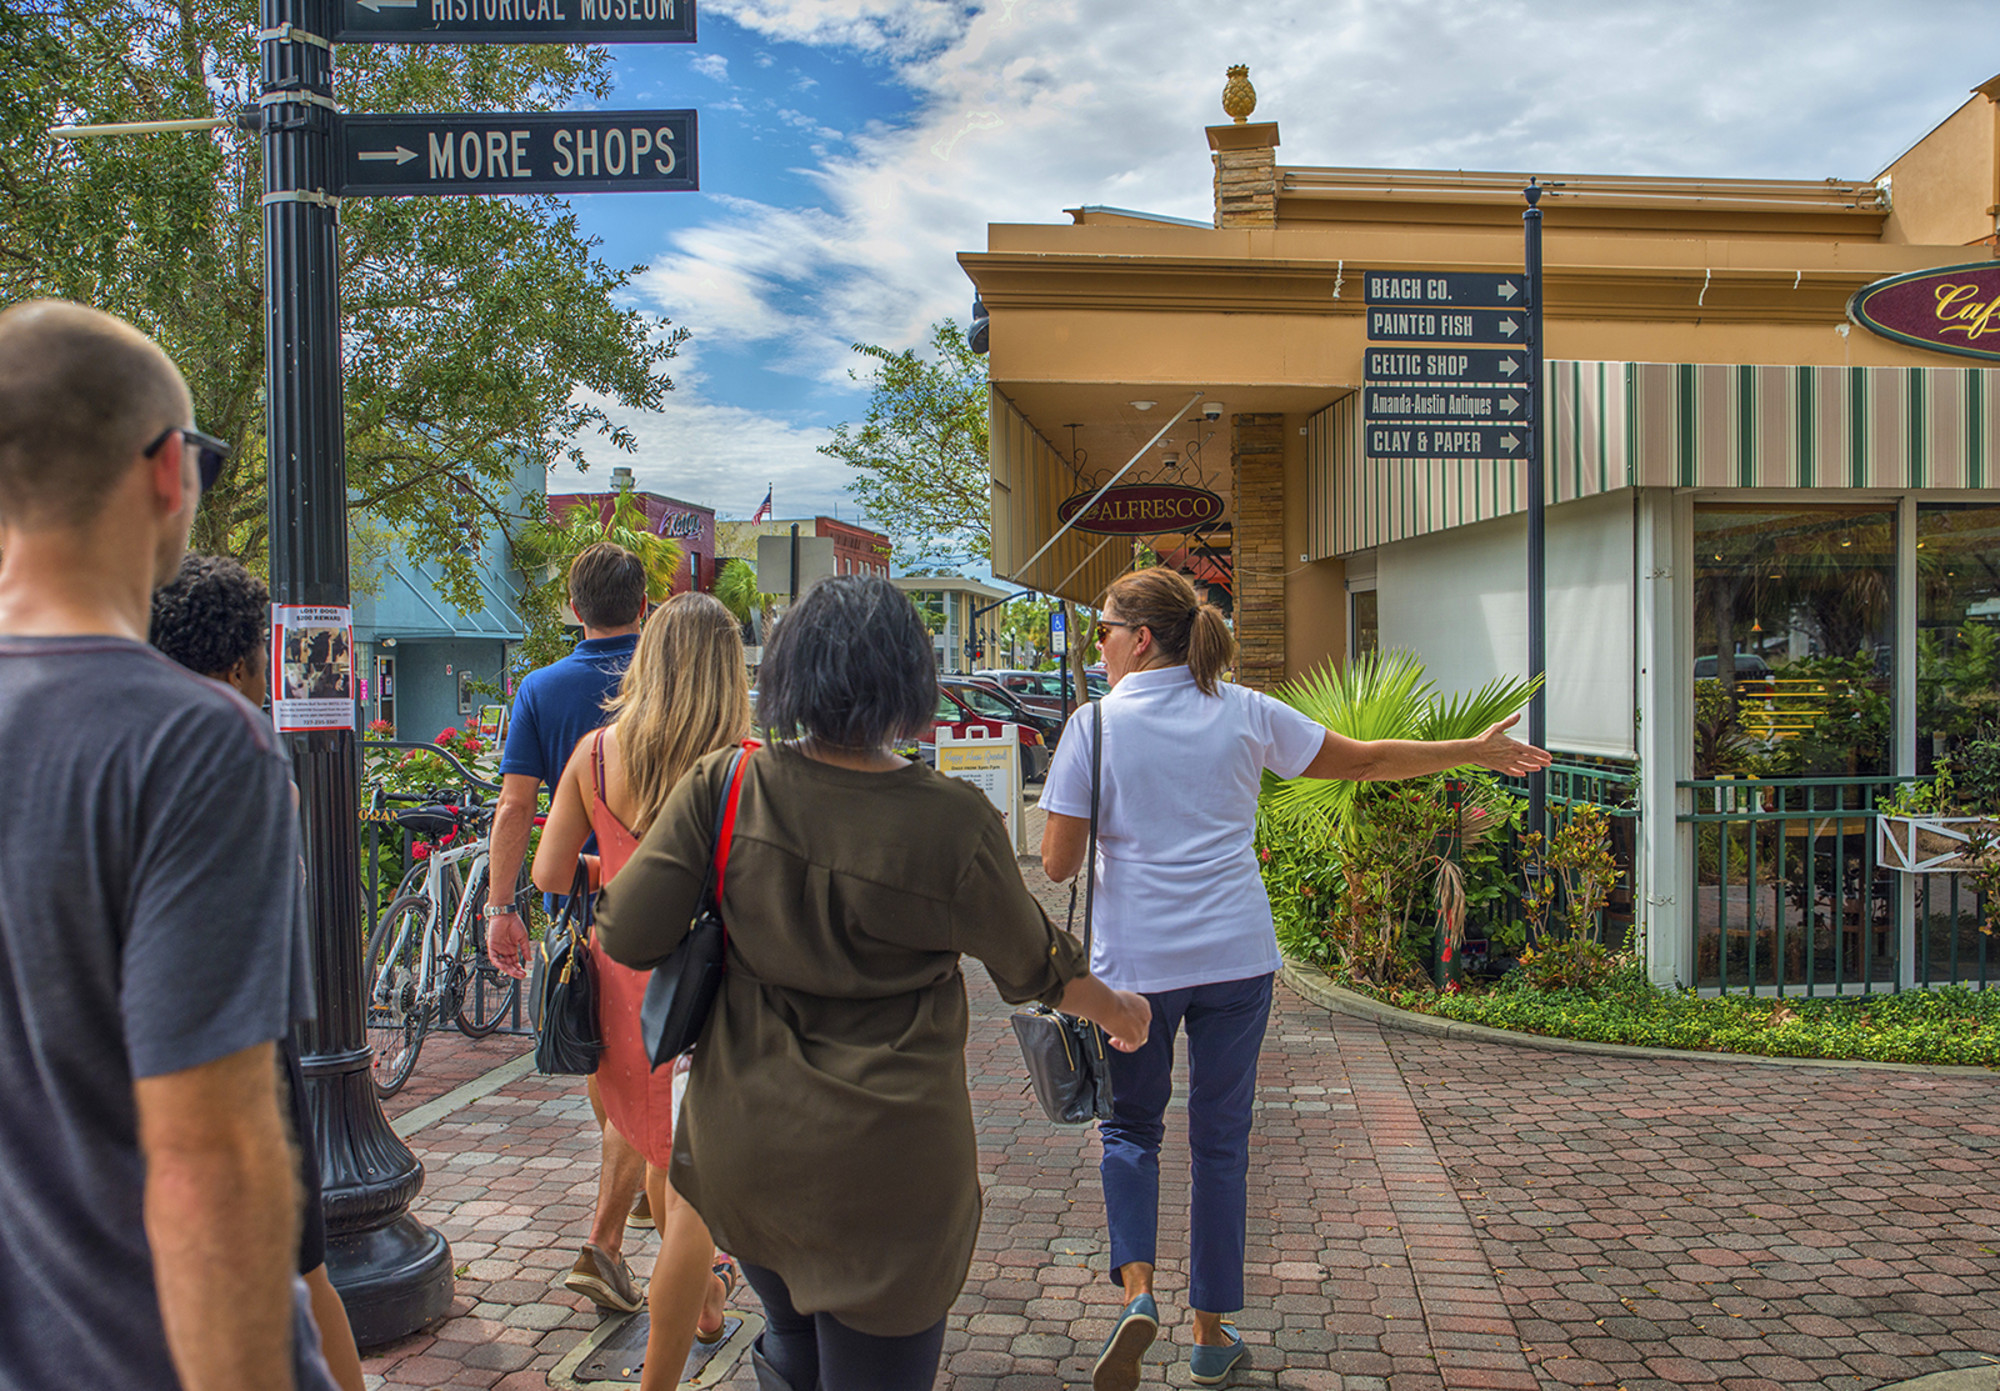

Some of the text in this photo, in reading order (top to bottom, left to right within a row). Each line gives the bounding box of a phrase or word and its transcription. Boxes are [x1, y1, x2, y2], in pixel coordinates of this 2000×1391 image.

[428, 127, 676, 179] MORE SHOPS
[1371, 278, 1452, 300] BEACH CO.
[1935, 284, 2000, 340] Caf
[1374, 313, 1473, 336] PAINTED FISH
[1372, 354, 1468, 376] CELTIC SHOP
[1449, 394, 1492, 418] Antiques
[1374, 431, 1481, 453] CLAY & PAPER
[1099, 497, 1211, 521] ALFRESCO
